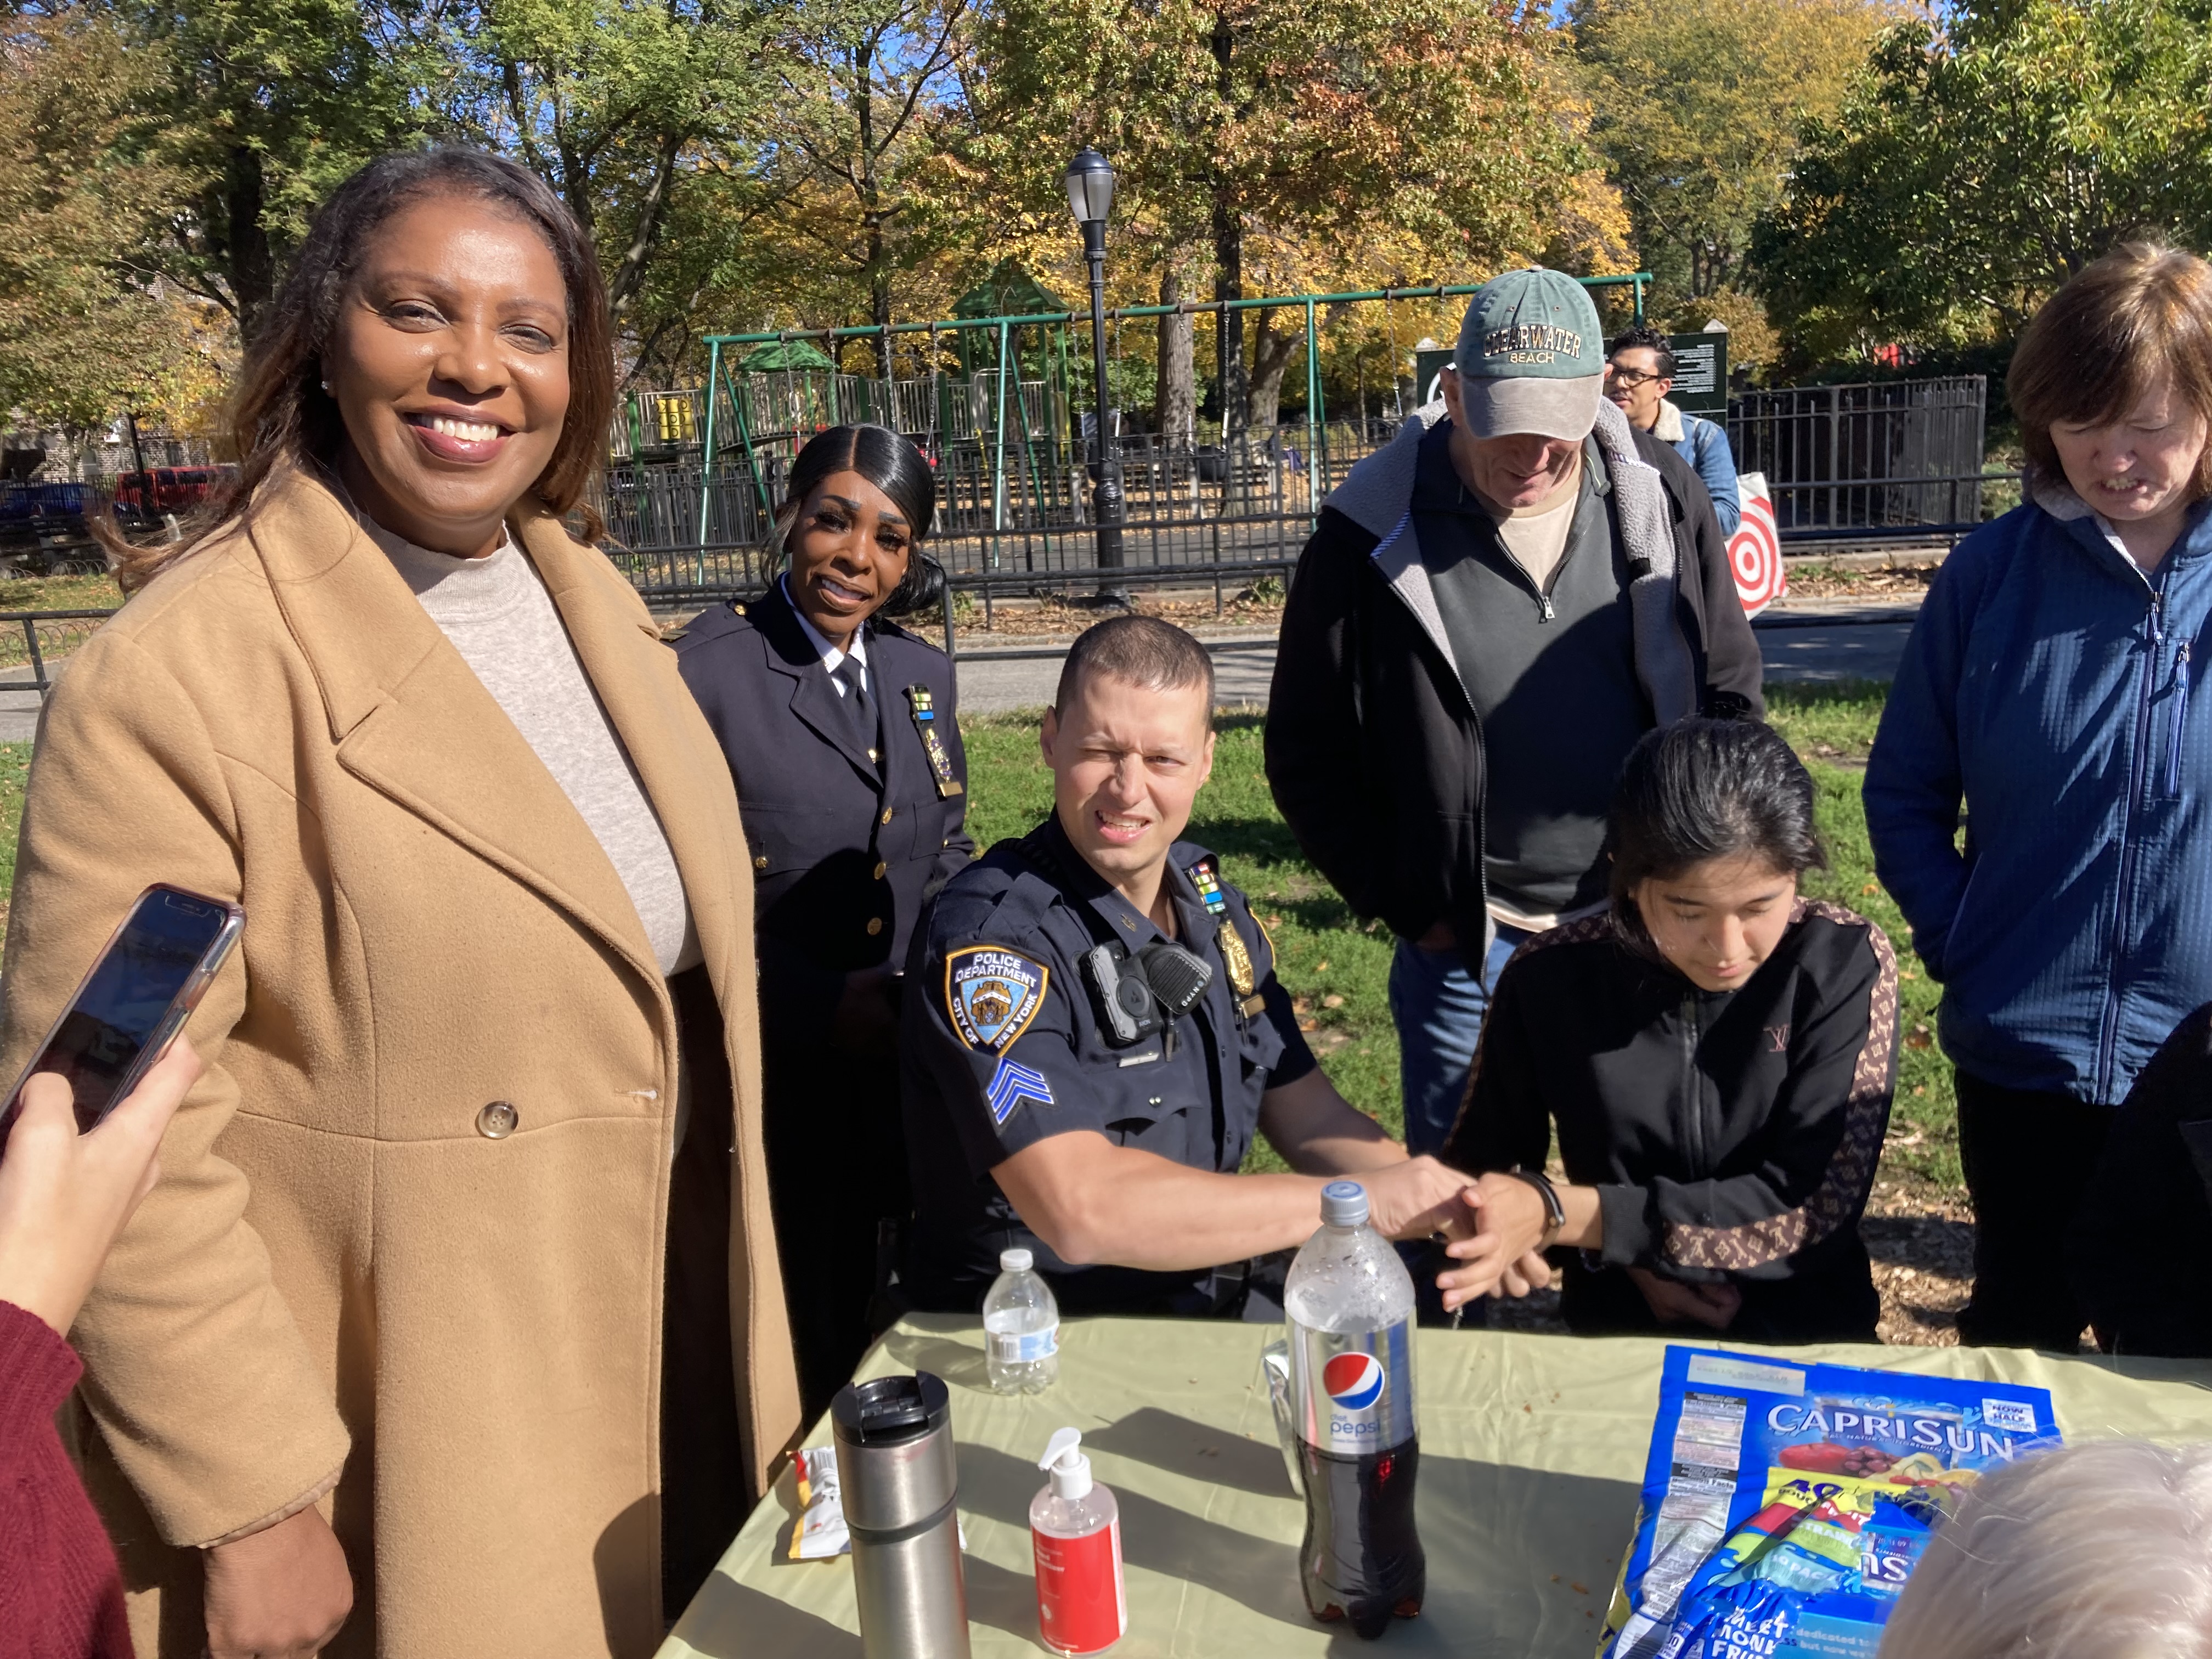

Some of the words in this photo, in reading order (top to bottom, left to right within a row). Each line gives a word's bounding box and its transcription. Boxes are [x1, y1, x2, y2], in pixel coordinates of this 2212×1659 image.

[1483, 325, 1582, 359] CLEARWATER
[1510, 352, 1555, 364] BEACH
[973, 953, 1022, 970] POLICE
[955, 964, 1037, 988] DEPARTMENT
[1181, 986, 1200, 1007] NYPD
[953, 997, 969, 1026] CITY
[964, 1027, 979, 1045] OF
[994, 1023, 1017, 1049] NEW
[1013, 993, 1038, 1024] YORK
[1993, 1406, 2023, 1414] NOW
[1330, 1418, 1381, 1437] pepsi
[1767, 1403, 2015, 1462] CAPRISUN
[1723, 1605, 1790, 1639] MEET
[1796, 1628, 1856, 1645] dedicated
